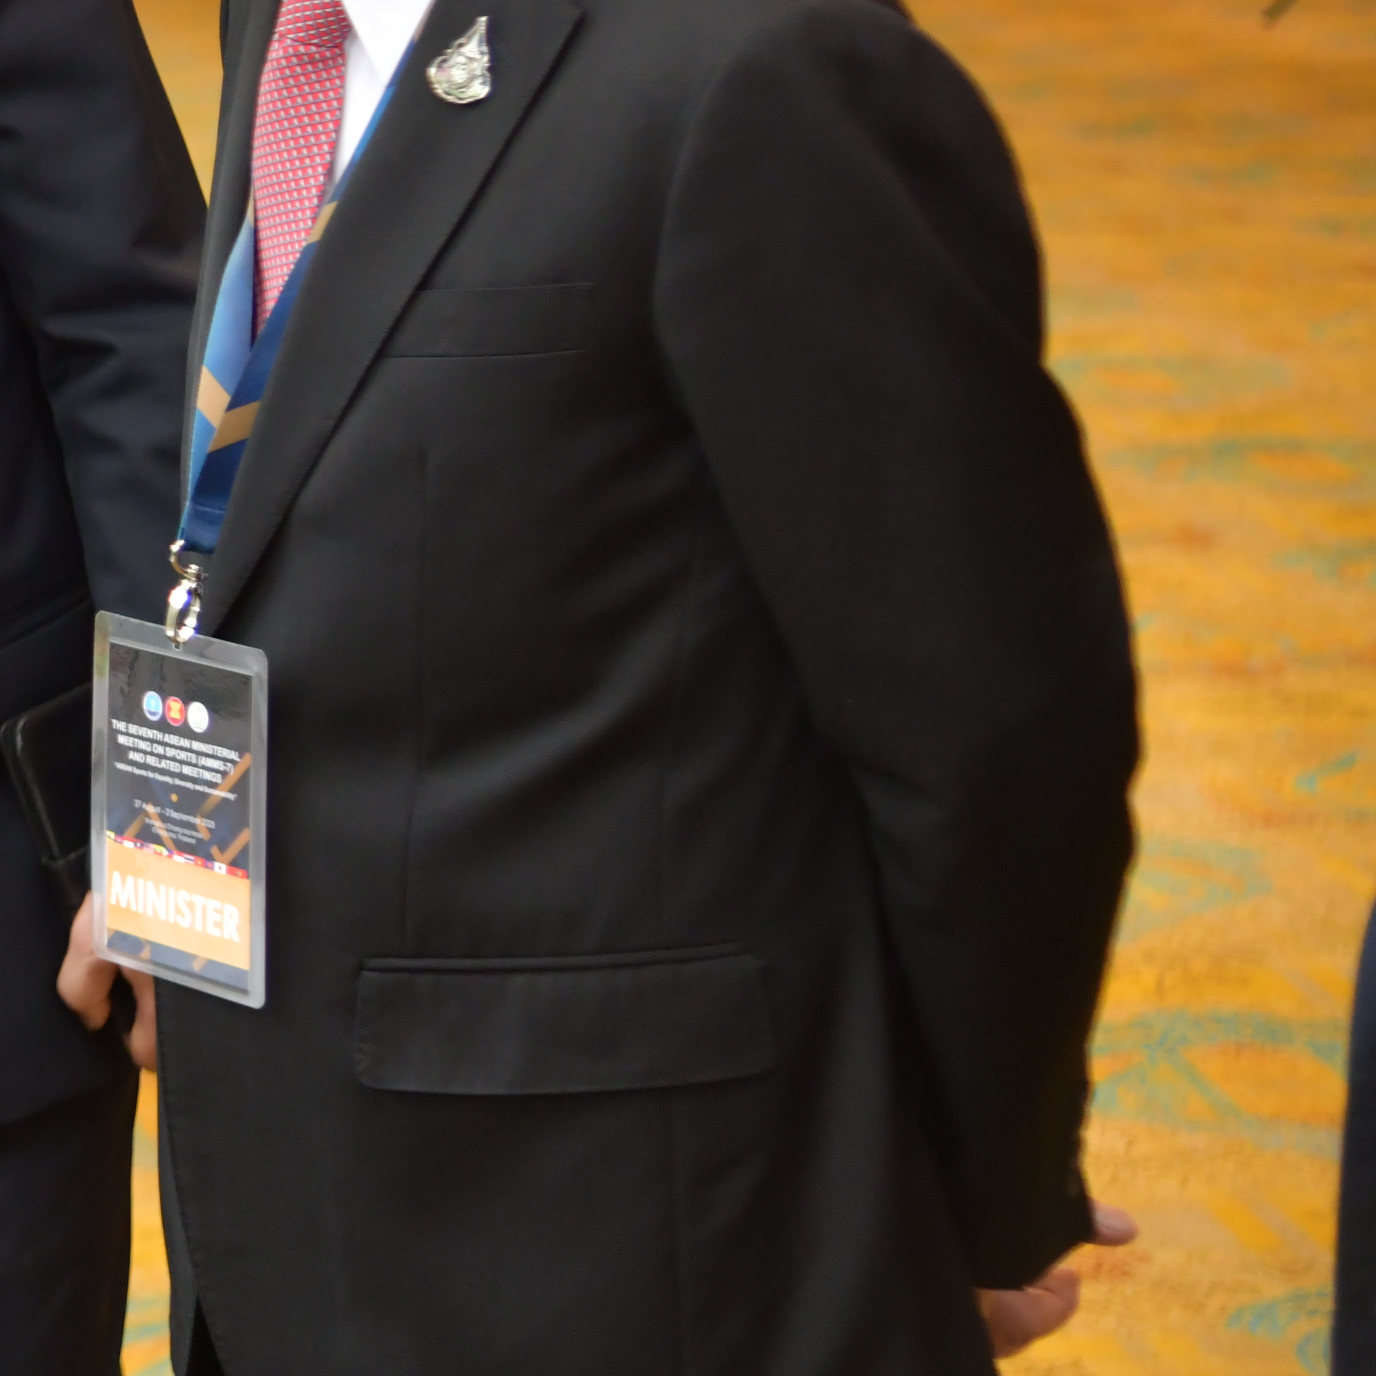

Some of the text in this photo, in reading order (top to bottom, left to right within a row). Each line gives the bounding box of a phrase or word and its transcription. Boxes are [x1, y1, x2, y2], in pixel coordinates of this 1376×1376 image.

[111, 718, 241, 761] THE SEVENTH ASEAN MINISTERIAL
[117, 734, 234, 775] MEETING ON SPORTS (AMMS-7)
[128, 750, 223, 784] AND RELATED MEETINGS
[110, 870, 240, 943] MINISTER
